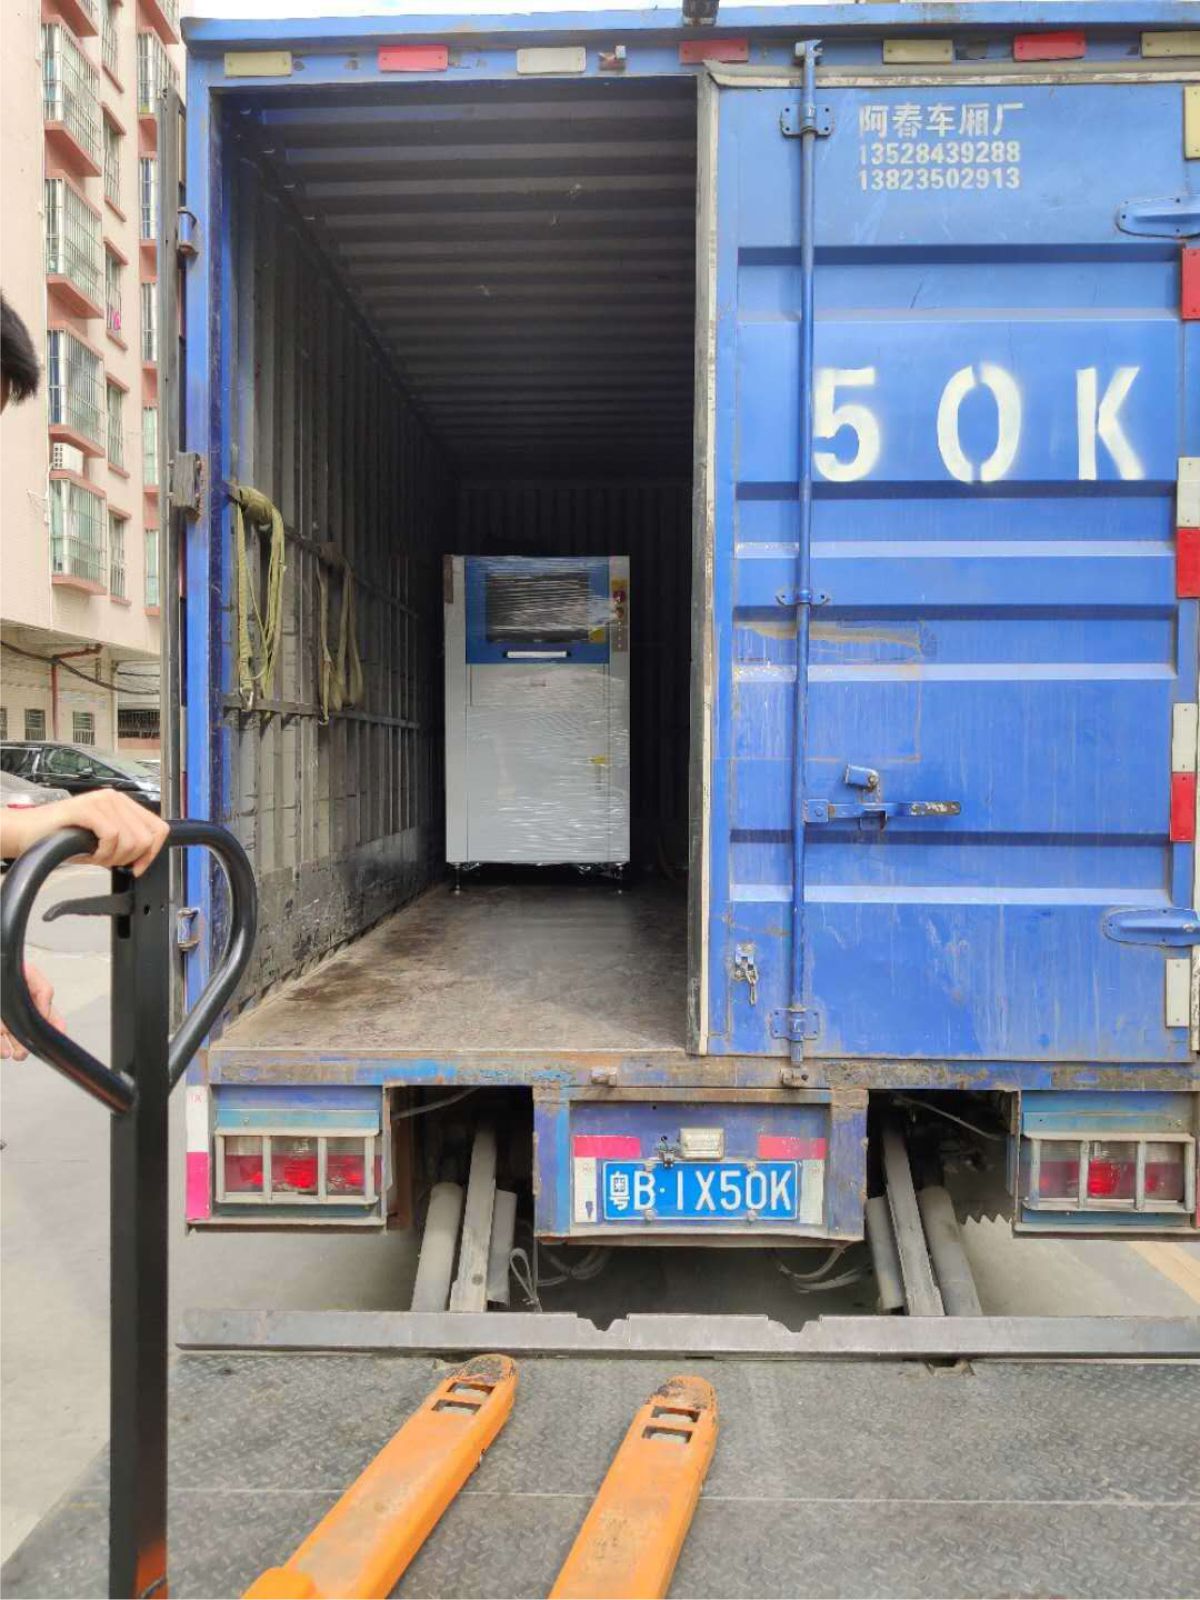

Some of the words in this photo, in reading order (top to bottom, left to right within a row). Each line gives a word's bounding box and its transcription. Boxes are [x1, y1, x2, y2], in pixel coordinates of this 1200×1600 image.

[859, 102, 1023, 138] 阿春车厢厂
[860, 140, 1021, 165] 13528439288
[859, 166, 1021, 191] 13823502913
